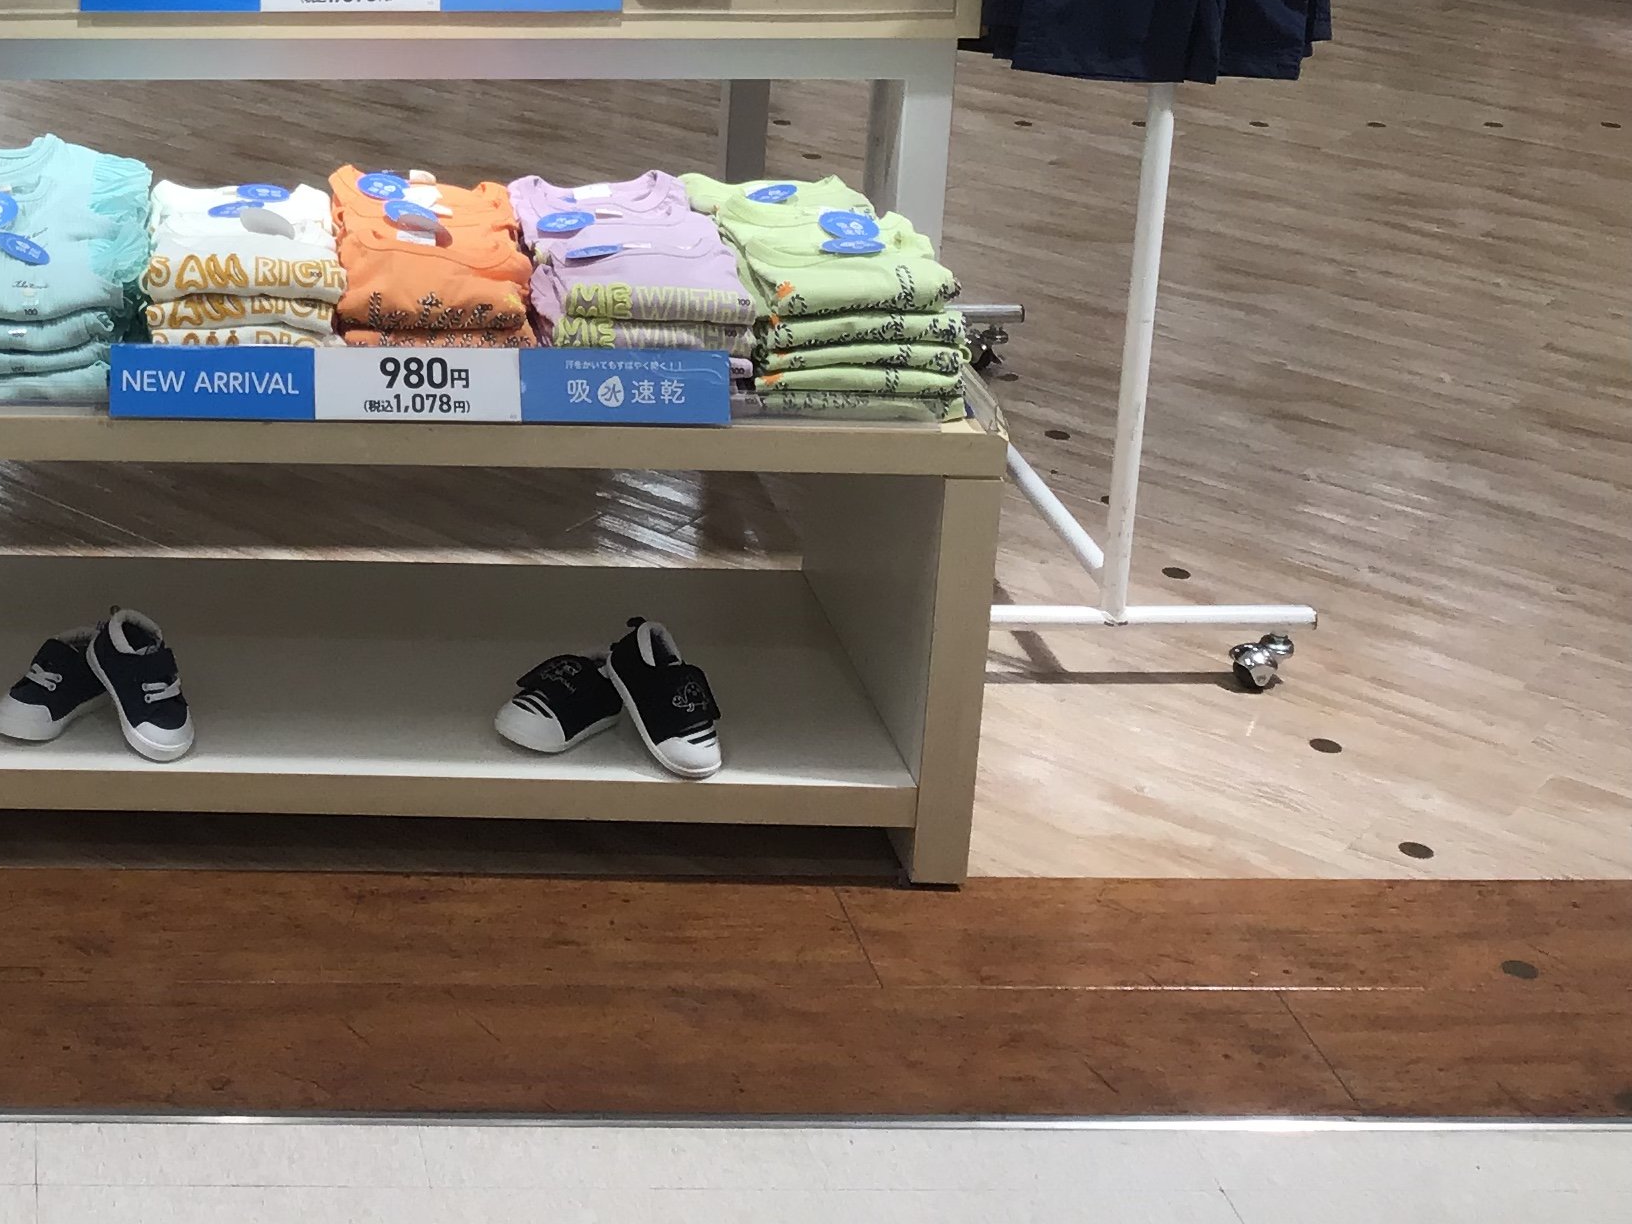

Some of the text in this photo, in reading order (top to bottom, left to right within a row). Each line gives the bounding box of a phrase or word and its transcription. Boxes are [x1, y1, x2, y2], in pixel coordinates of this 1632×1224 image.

[24, 308, 39, 316] 100
[737, 298, 751, 307] 100
[121, 369, 300, 395] NEW ARRIVAL
[379, 356, 471, 389] 980円
[567, 375, 686, 408] 吸水速乾
[363, 393, 471, 414] (税込1,078円)
